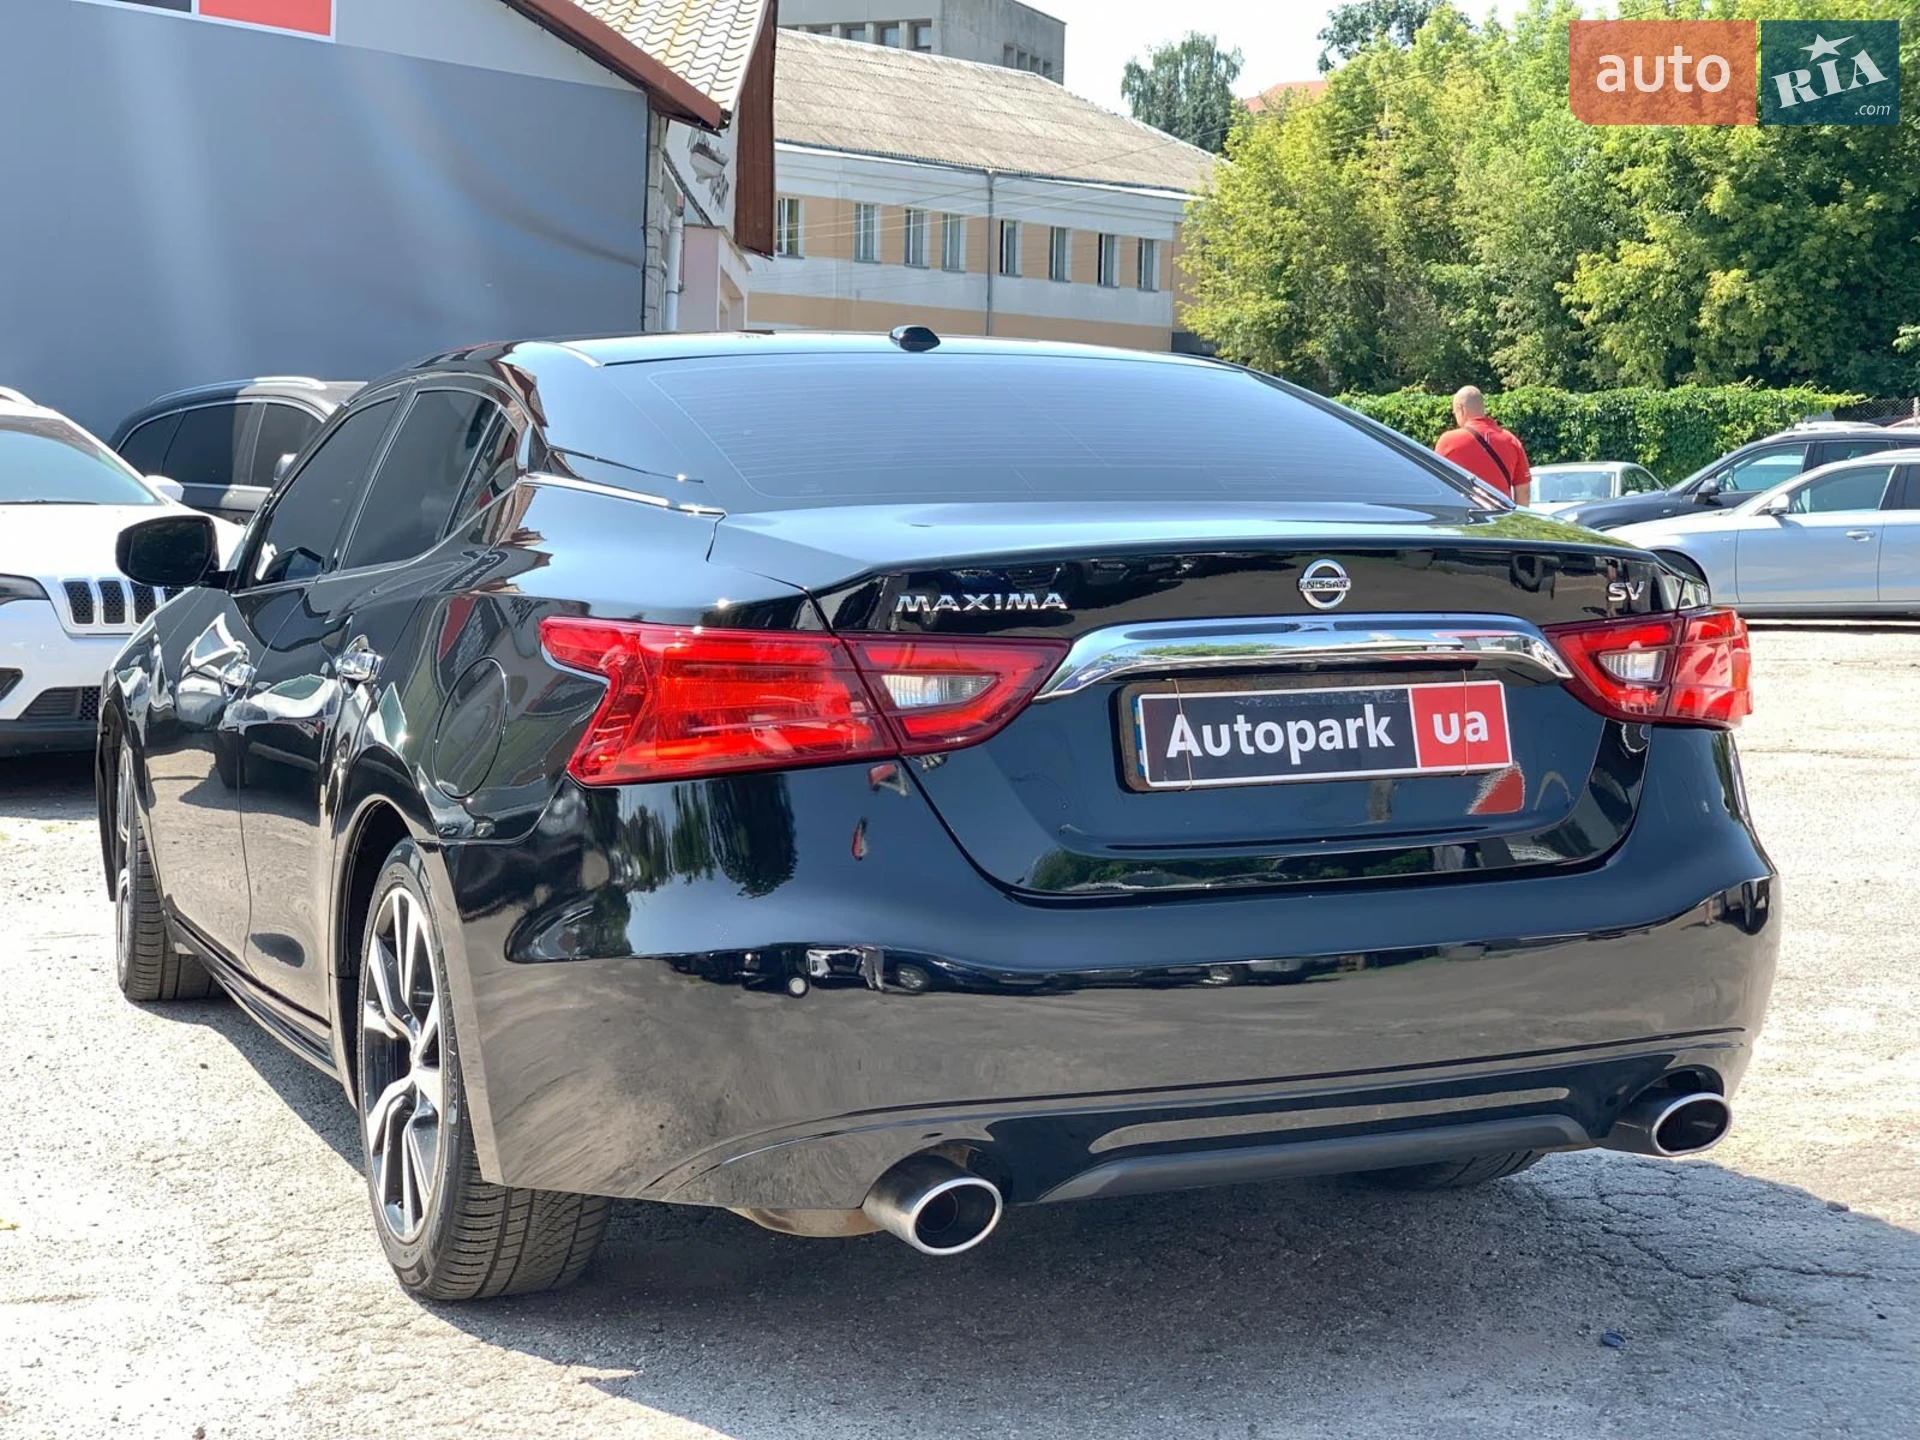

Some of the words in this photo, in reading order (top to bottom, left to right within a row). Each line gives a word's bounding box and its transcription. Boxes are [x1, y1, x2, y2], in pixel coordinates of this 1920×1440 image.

[1306, 580, 1347, 589] NISSAN
[1607, 581, 1645, 602] SV
[895, 592, 1068, 613] MAXIMA
[1166, 703, 1395, 766] Autopark
[1432, 709, 1489, 744] ua
